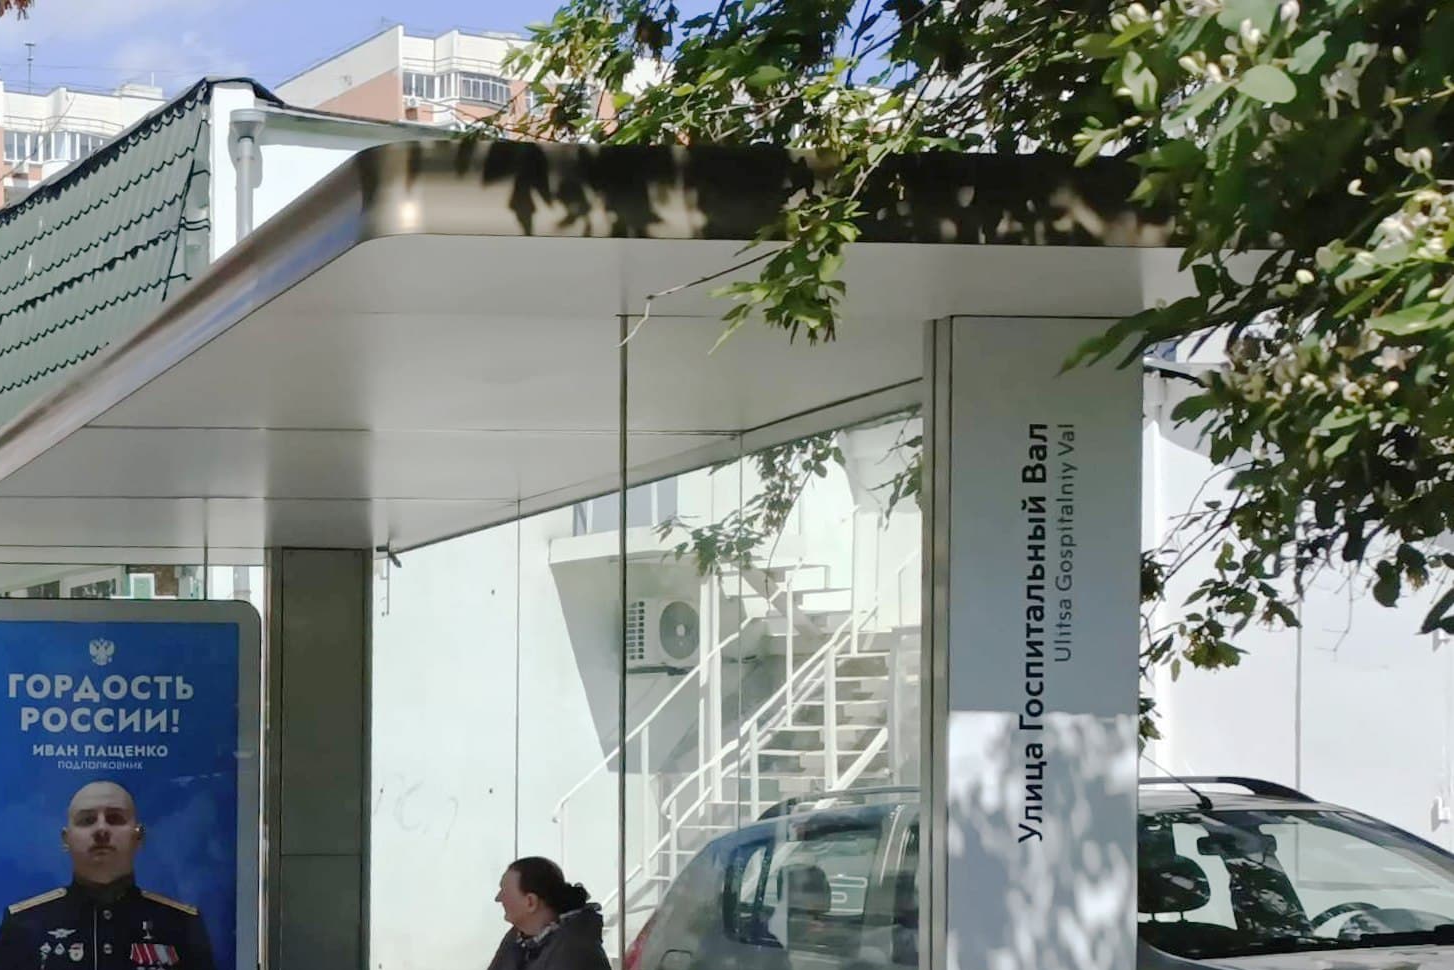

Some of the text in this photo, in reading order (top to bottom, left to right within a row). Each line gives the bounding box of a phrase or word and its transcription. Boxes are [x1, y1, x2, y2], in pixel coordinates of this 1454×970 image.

[1053, 424, 1078, 662] Ulitsa Gospitalniy Val
[1018, 423, 1048, 843] Улица Госпитальный Вал
[7, 673, 194, 702] ГОРДОСТЬ
[20, 706, 180, 733] РОССИИ!
[33, 744, 168, 759] ИВАН ПАЩЕНКО
